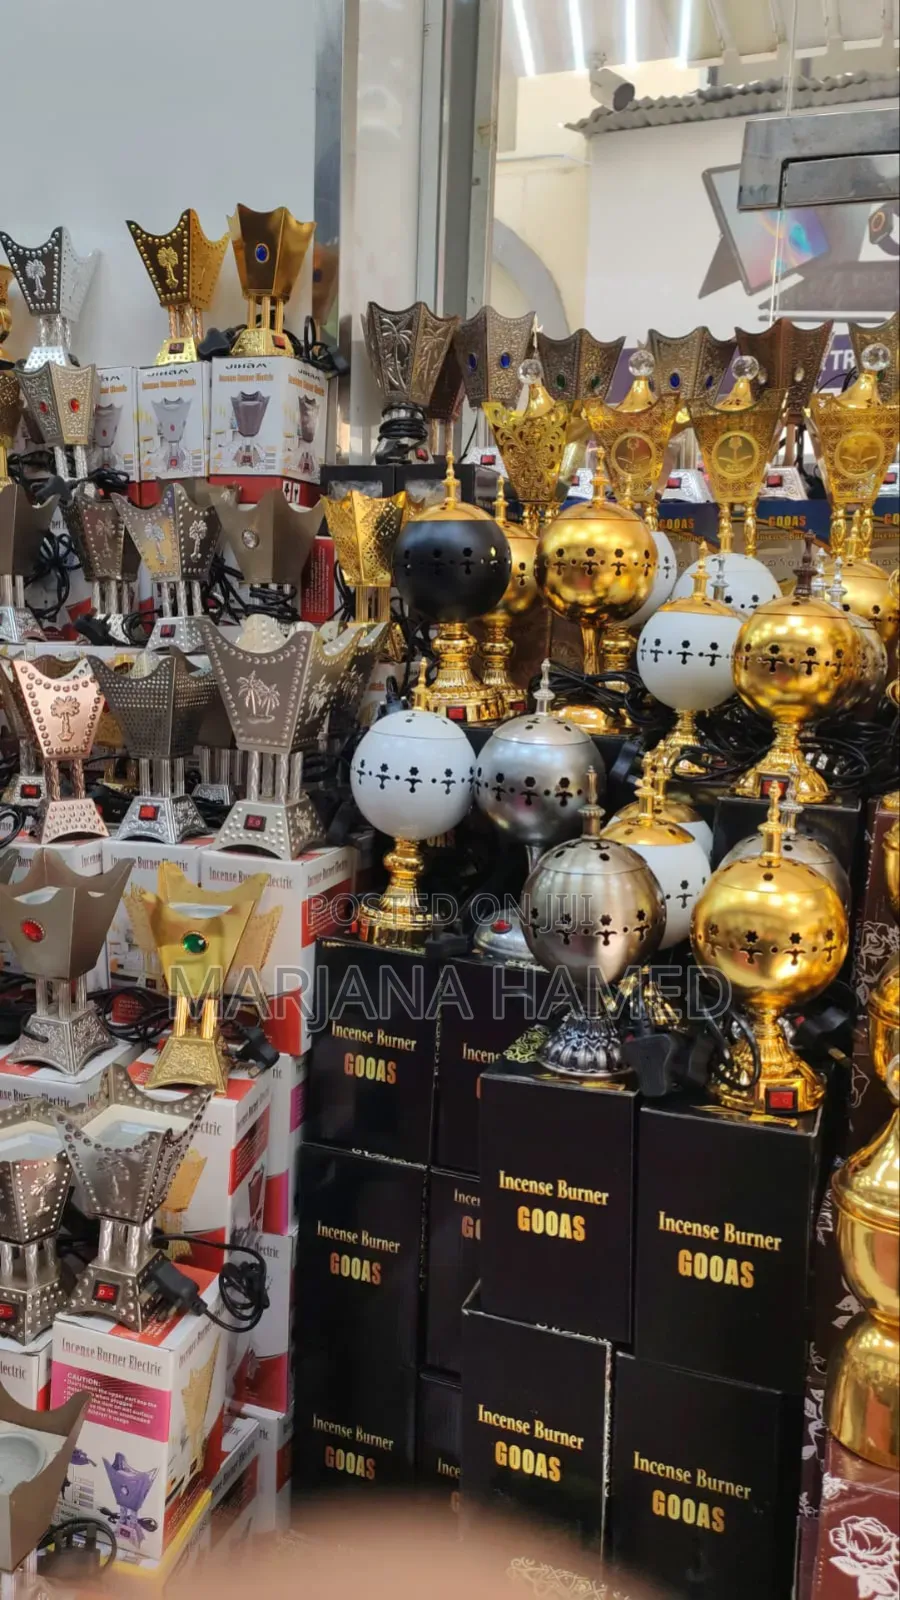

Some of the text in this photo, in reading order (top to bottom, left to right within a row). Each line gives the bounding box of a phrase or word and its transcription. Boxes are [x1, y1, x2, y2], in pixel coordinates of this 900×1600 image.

[768, 515, 806, 527] GOOAS
[209, 866, 237, 883] Incense
[332, 1020, 417, 1052] Incense Burner
[344, 1052, 397, 1085] GOOAS
[499, 1169, 609, 1206] Incense Burner
[316, 1219, 400, 1255] Incense Burner
[517, 1205, 586, 1242] GOOAS
[658, 1210, 782, 1252] Incense Burner
[329, 1251, 382, 1286] GOOAS
[678, 1248, 754, 1289] GOOAS
[62, 1337, 162, 1377] Incense Burner Electric
[312, 1413, 353, 1440] Incense
[356, 1424, 394, 1451] Burner
[478, 1404, 584, 1450] Incense Burner
[325, 1445, 376, 1480] GOOAS
[495, 1440, 561, 1483] GOOAS
[633, 1450, 752, 1500] Incense Burner
[652, 1489, 725, 1533] GOOAS
